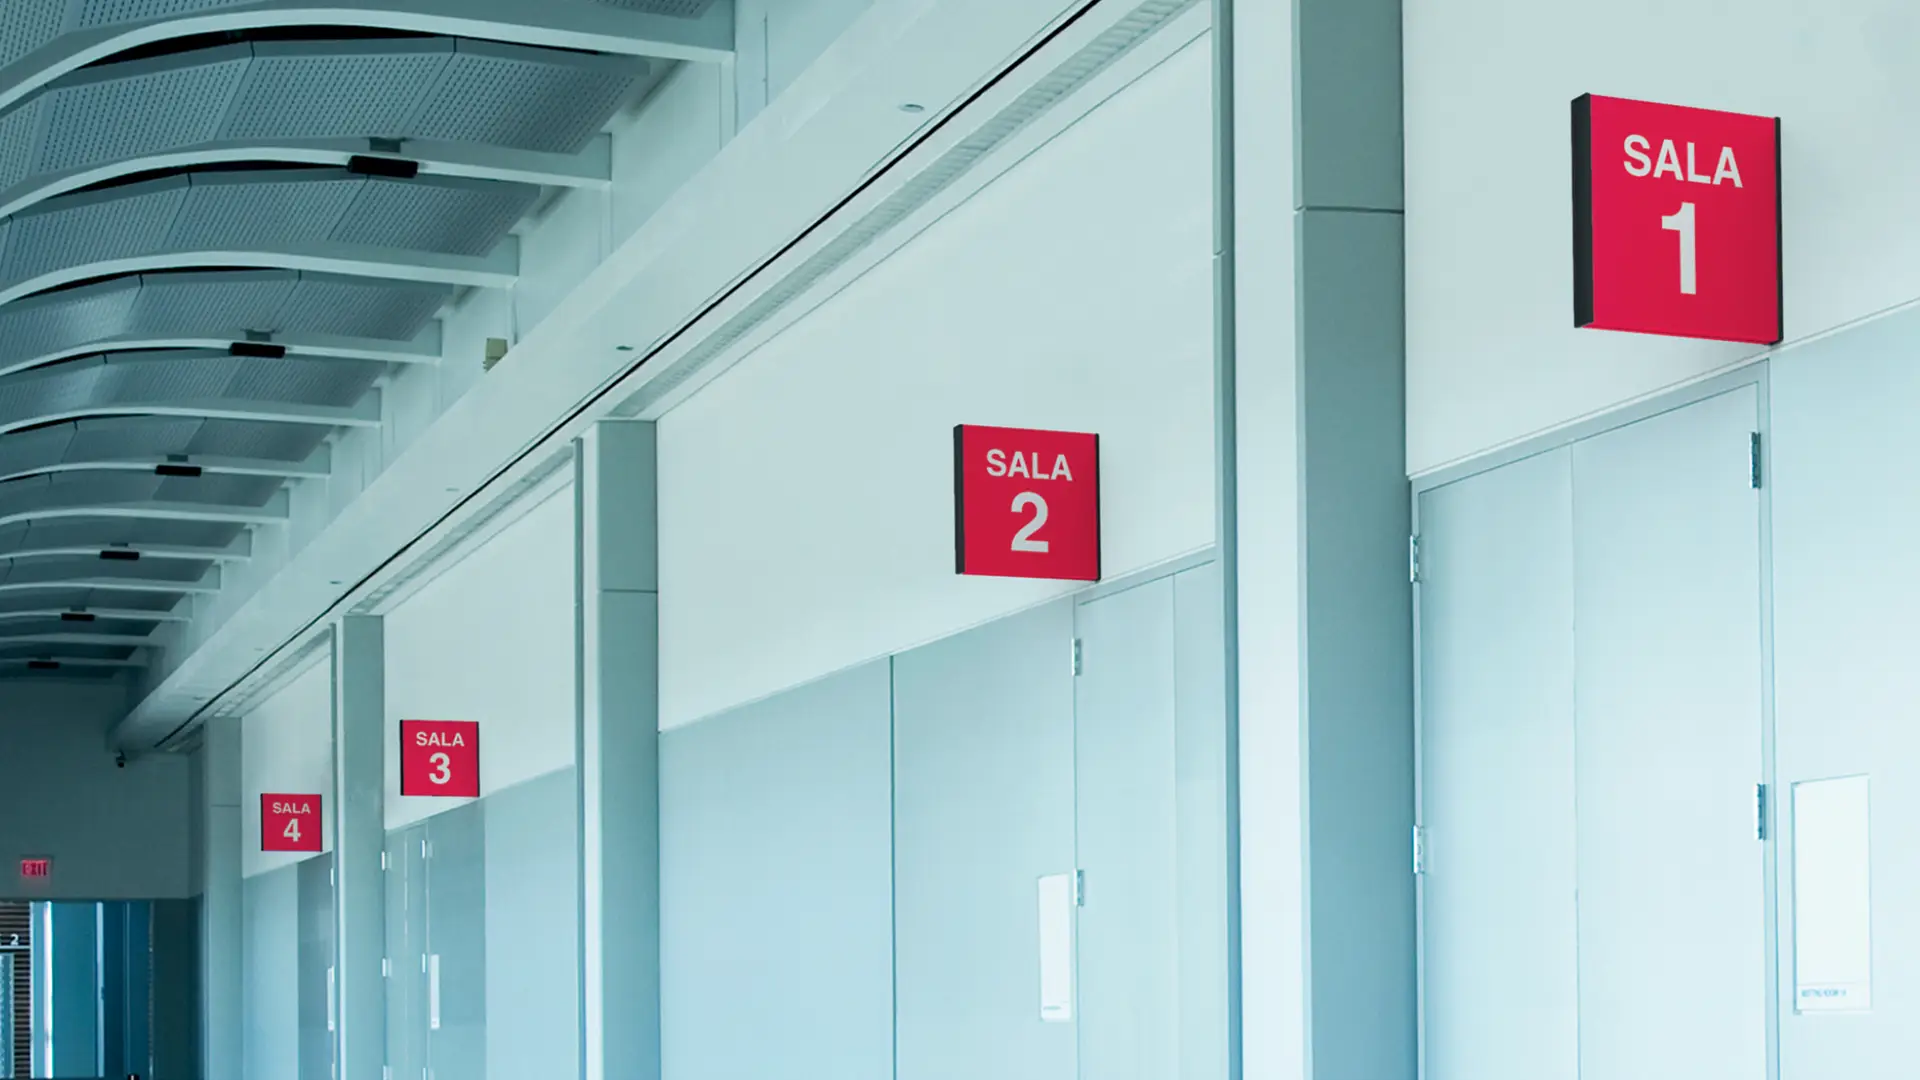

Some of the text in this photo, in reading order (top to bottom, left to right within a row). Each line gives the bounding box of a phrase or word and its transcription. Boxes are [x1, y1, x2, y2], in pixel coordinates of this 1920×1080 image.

[1624, 134, 1742, 188] SALA
[1662, 202, 1696, 294] 1
[987, 449, 1072, 481] SALA
[1011, 492, 1048, 552] 2
[416, 732, 465, 747] SALA
[428, 753, 451, 785] 3
[272, 802, 311, 814] SALA
[283, 819, 302, 841] 4
[10, 933, 19, 946] 2
